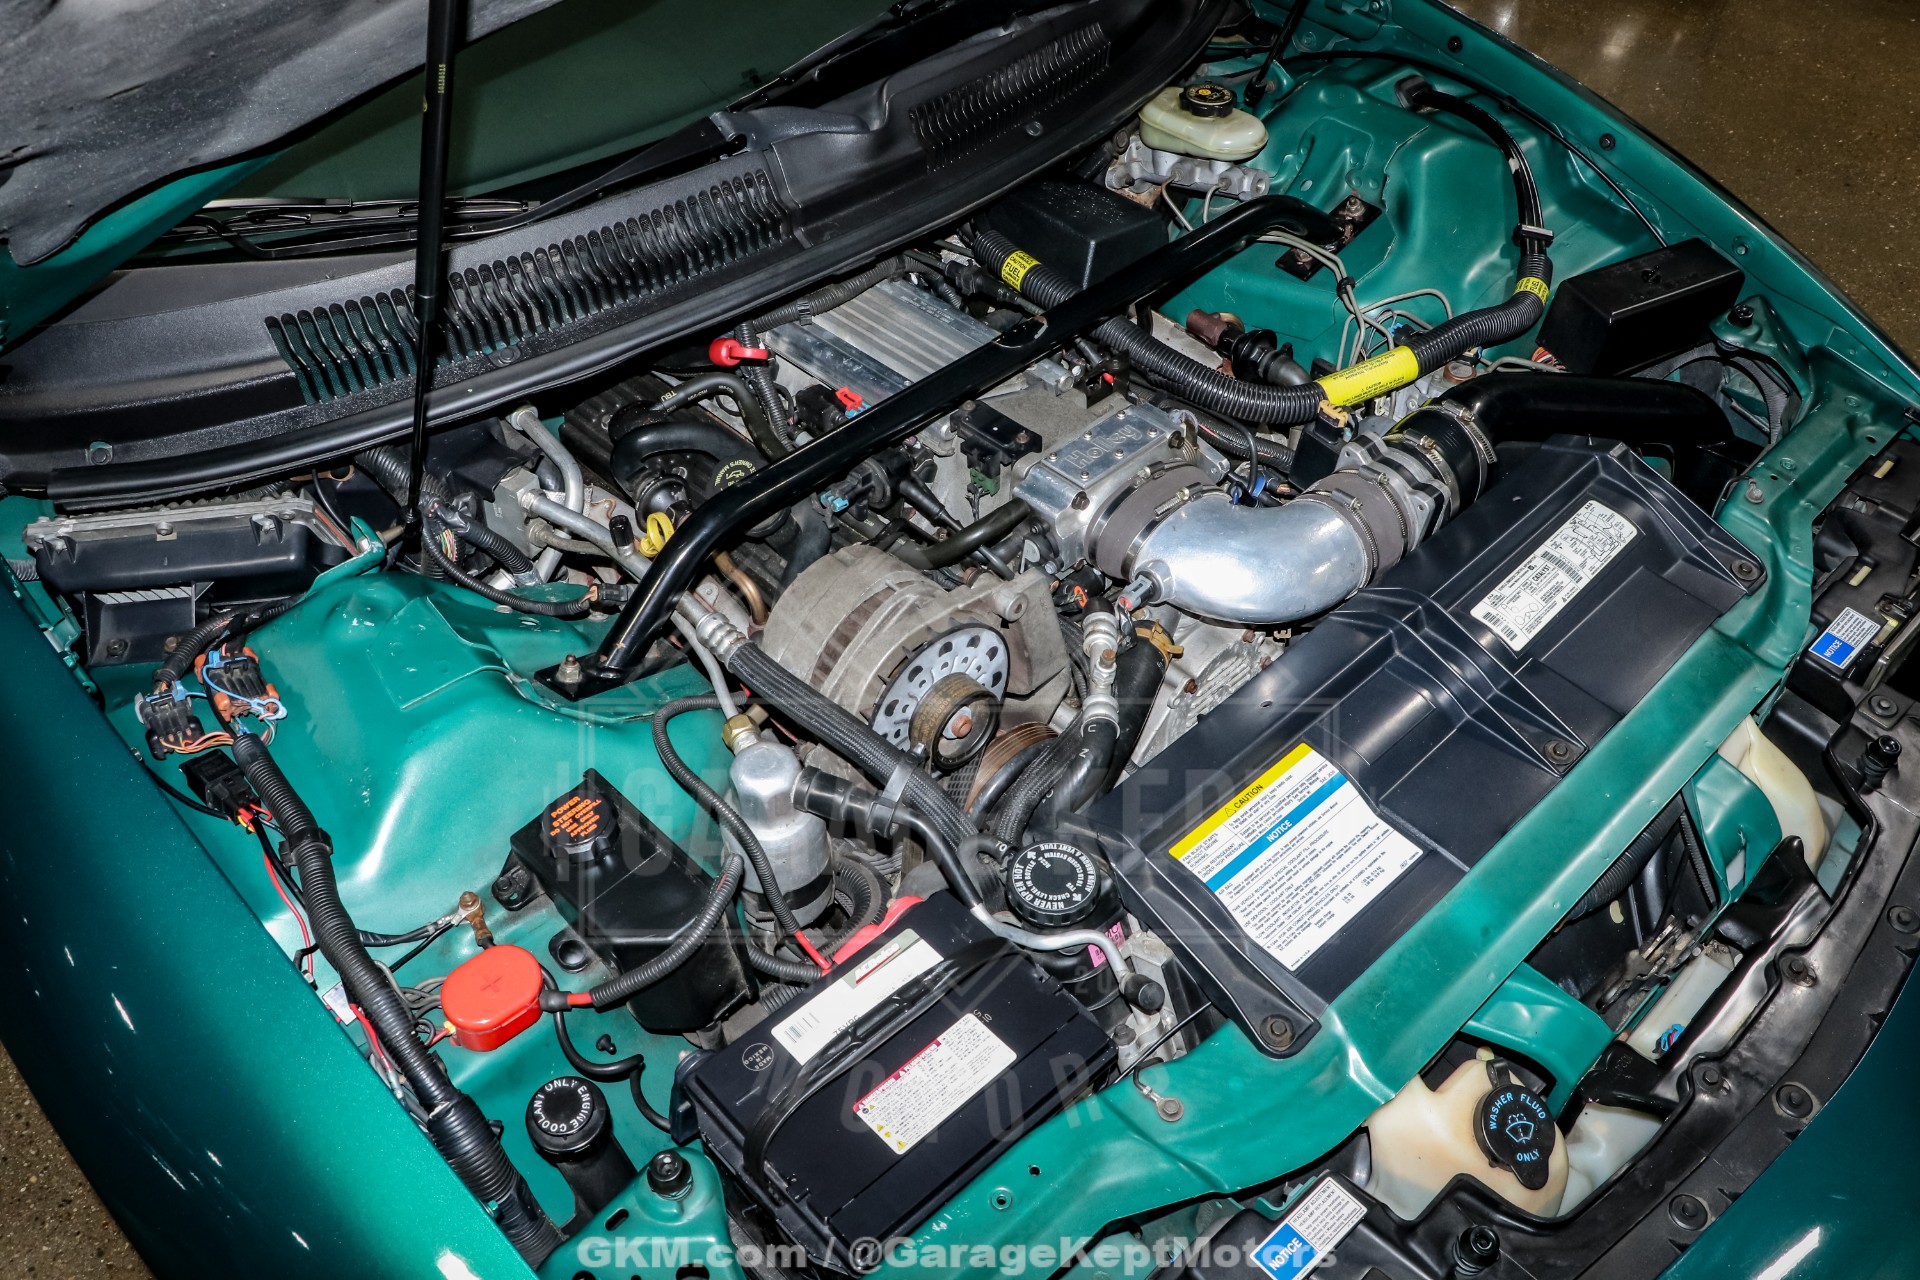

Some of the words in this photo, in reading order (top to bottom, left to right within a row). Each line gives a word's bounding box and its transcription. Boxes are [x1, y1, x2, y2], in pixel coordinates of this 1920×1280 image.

[1004, 262, 1020, 278] FUEL
[1065, 424, 1143, 470] Holley
[714, 465, 730, 487] MANUAL
[1531, 564, 1551, 582] CATALYST
[1823, 639, 1842, 657] NOTICE
[1232, 783, 1264, 809] CAUTION
[551, 796, 580, 818] POWER
[552, 799, 591, 827] STEERING
[550, 828, 560, 836] DO
[570, 815, 600, 837] APPROVED
[580, 823, 598, 837] FLUID
[1265, 819, 1292, 842] NOTICE
[1044, 852, 1068, 860] SYSTEM
[1067, 856, 1083, 873] CLOSED
[1014, 863, 1025, 880] HOT
[1024, 860, 1037, 880] BOTTLE
[1015, 880, 1034, 901] OPEN
[1030, 886, 1048, 899] LEVEL
[1048, 892, 1071, 901] CHECK
[1033, 898, 1065, 910] NEVER
[851, 941, 901, 979] ACDelco
[744, 1045, 768, 1065] MEXICO
[754, 1055, 772, 1070] MADE
[755, 1055, 763, 1063] IN
[544, 1078, 578, 1092] ONLY
[533, 1094, 567, 1132] COOLANT
[570, 1085, 591, 1129] ENGINE
[1489, 1092, 1514, 1130] WASHER
[1520, 1093, 1546, 1119] FLUID
[1516, 1148, 1540, 1162] ONLY
[1268, 1236, 1302, 1271] NOTICE
